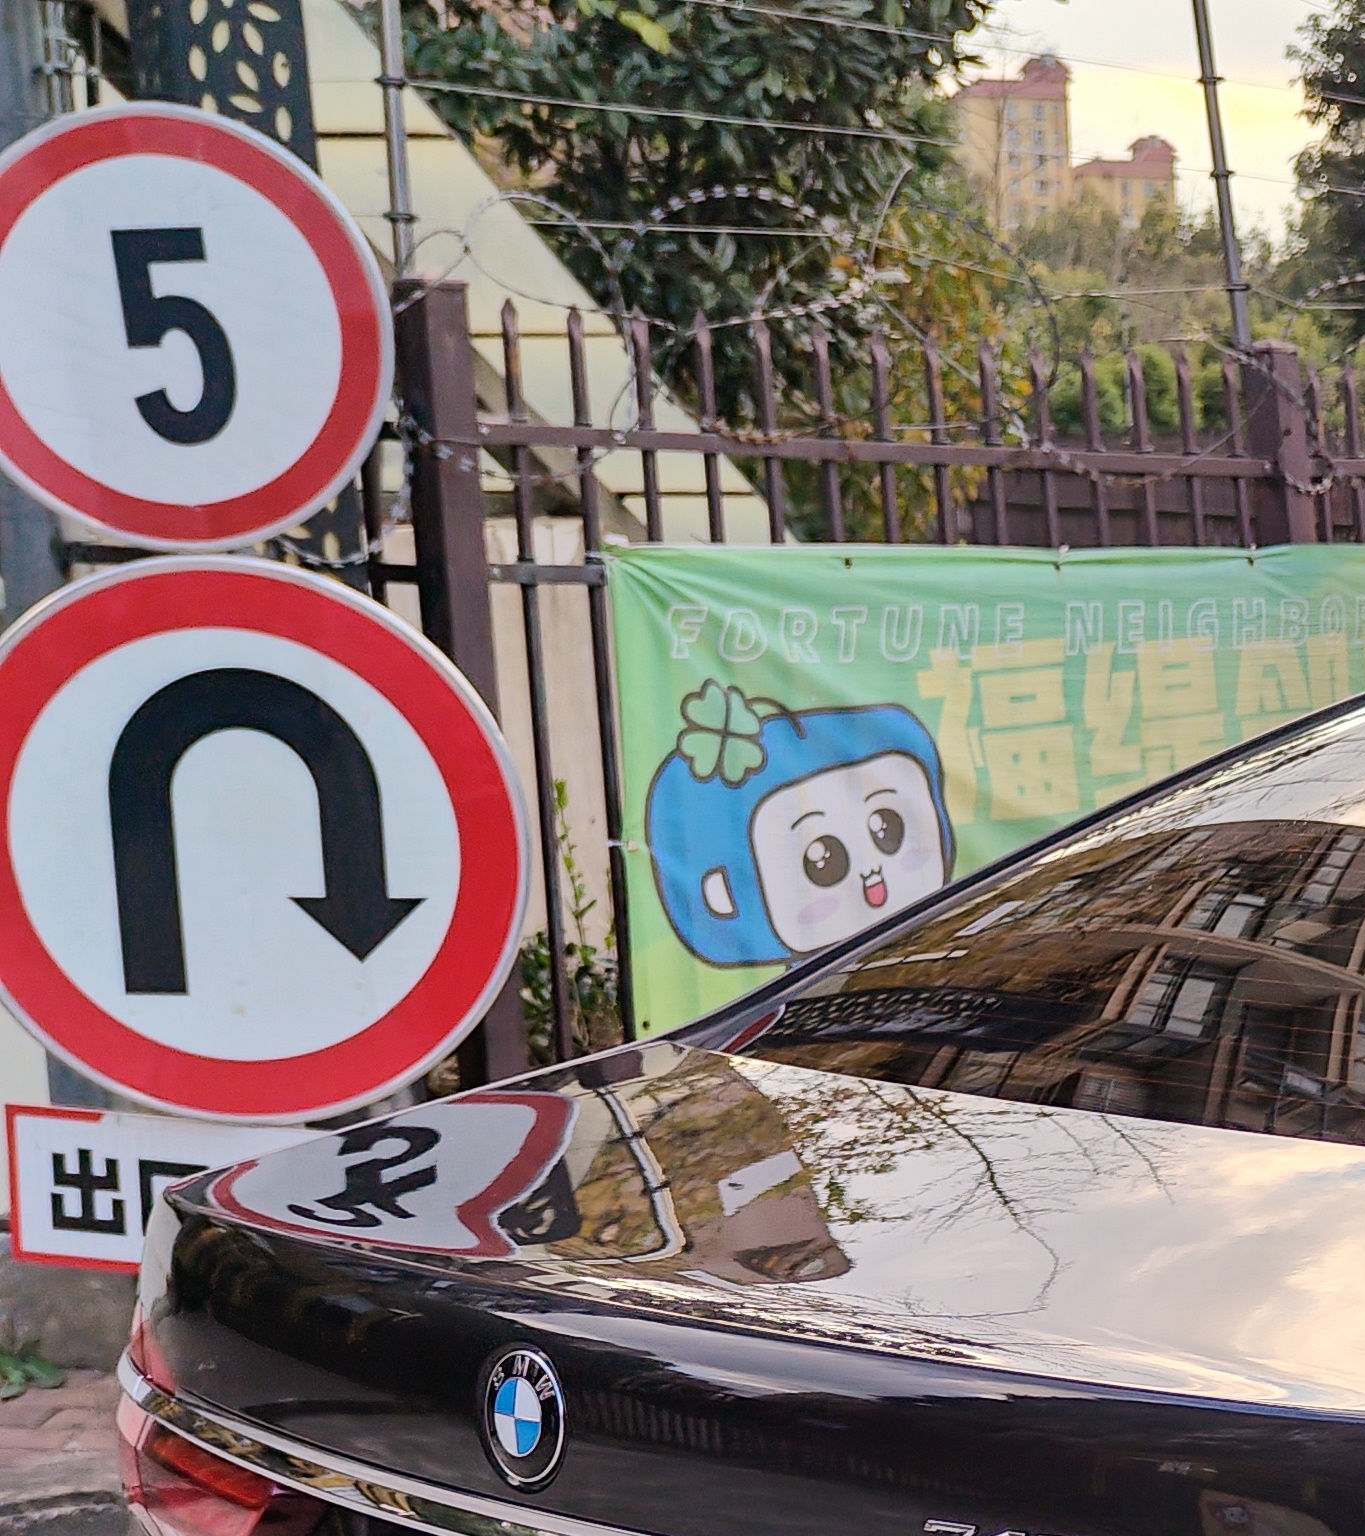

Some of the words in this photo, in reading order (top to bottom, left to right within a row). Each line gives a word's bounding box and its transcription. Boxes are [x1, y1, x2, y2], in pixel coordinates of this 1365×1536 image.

[110, 226, 237, 446] 5
[667, 602, 1025, 664] FORTUNE
[493, 1355, 555, 1401] BMW
